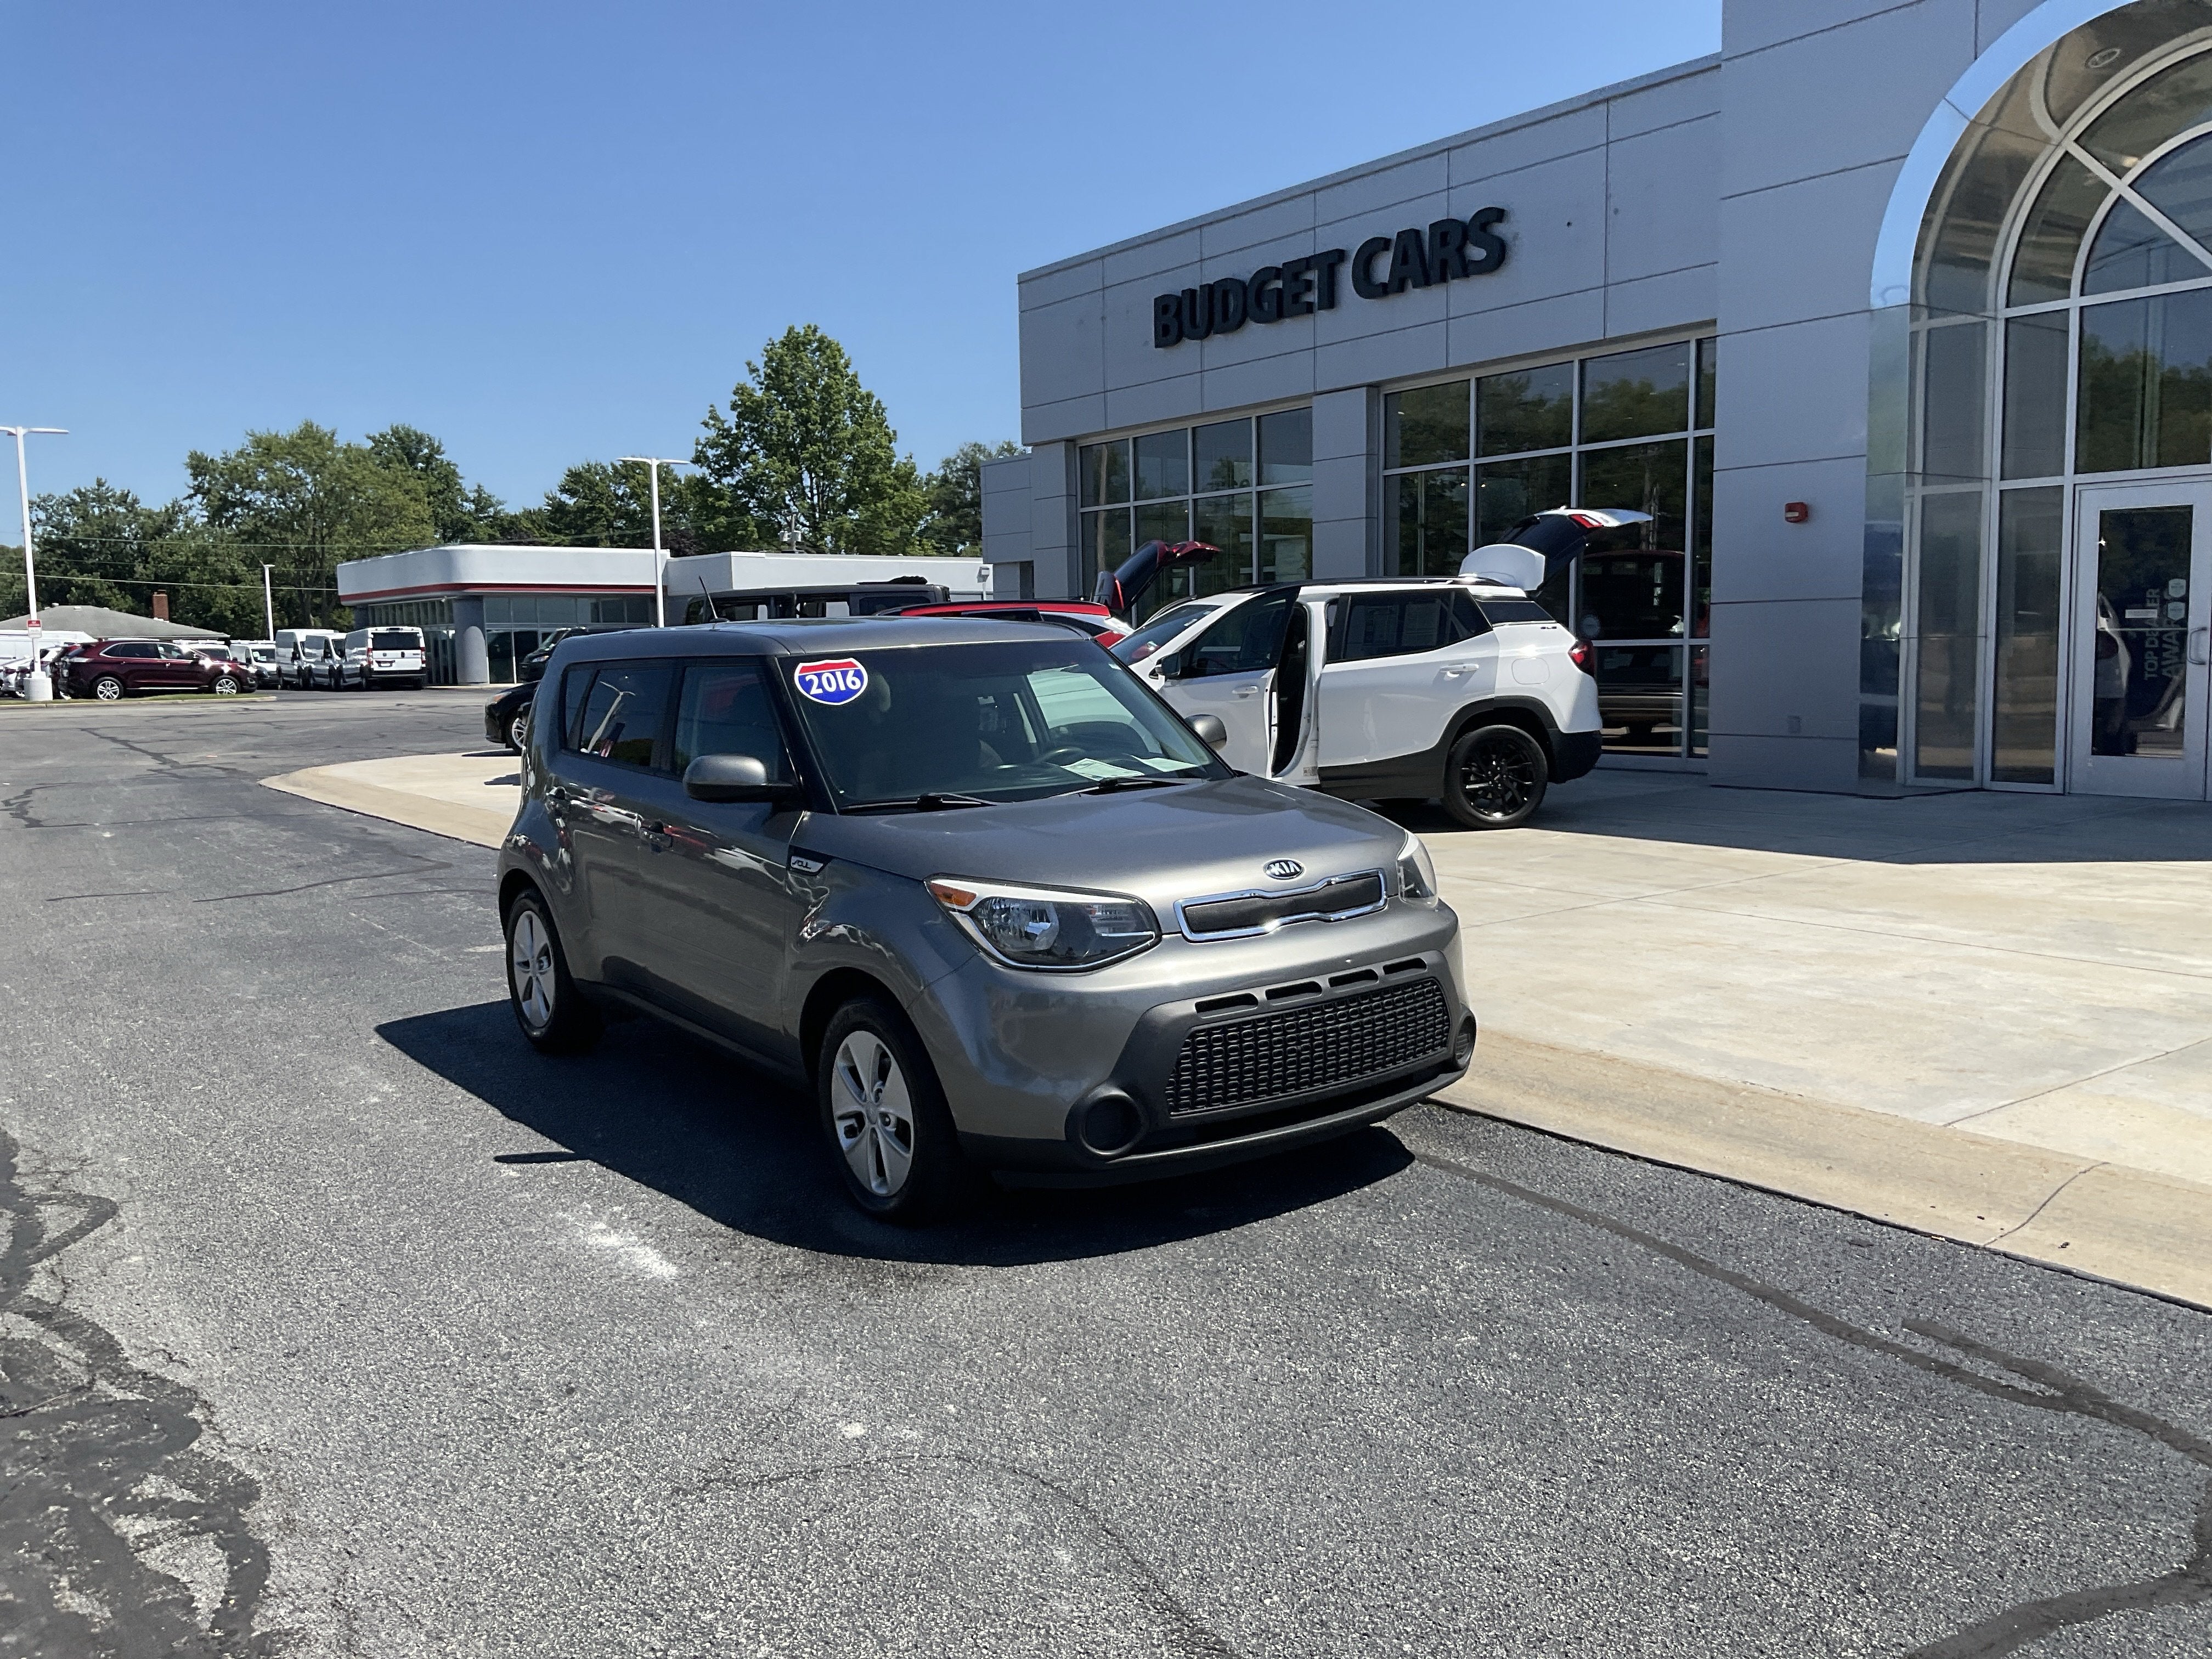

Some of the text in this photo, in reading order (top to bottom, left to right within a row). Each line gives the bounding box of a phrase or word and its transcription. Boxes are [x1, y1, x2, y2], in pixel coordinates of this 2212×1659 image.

[1153, 206, 1506, 349] BUDGET CARS
[2143, 588, 2160, 680] TOP DEAER
[805, 670, 861, 695] 2016
[1269, 861, 1301, 876] KIA
